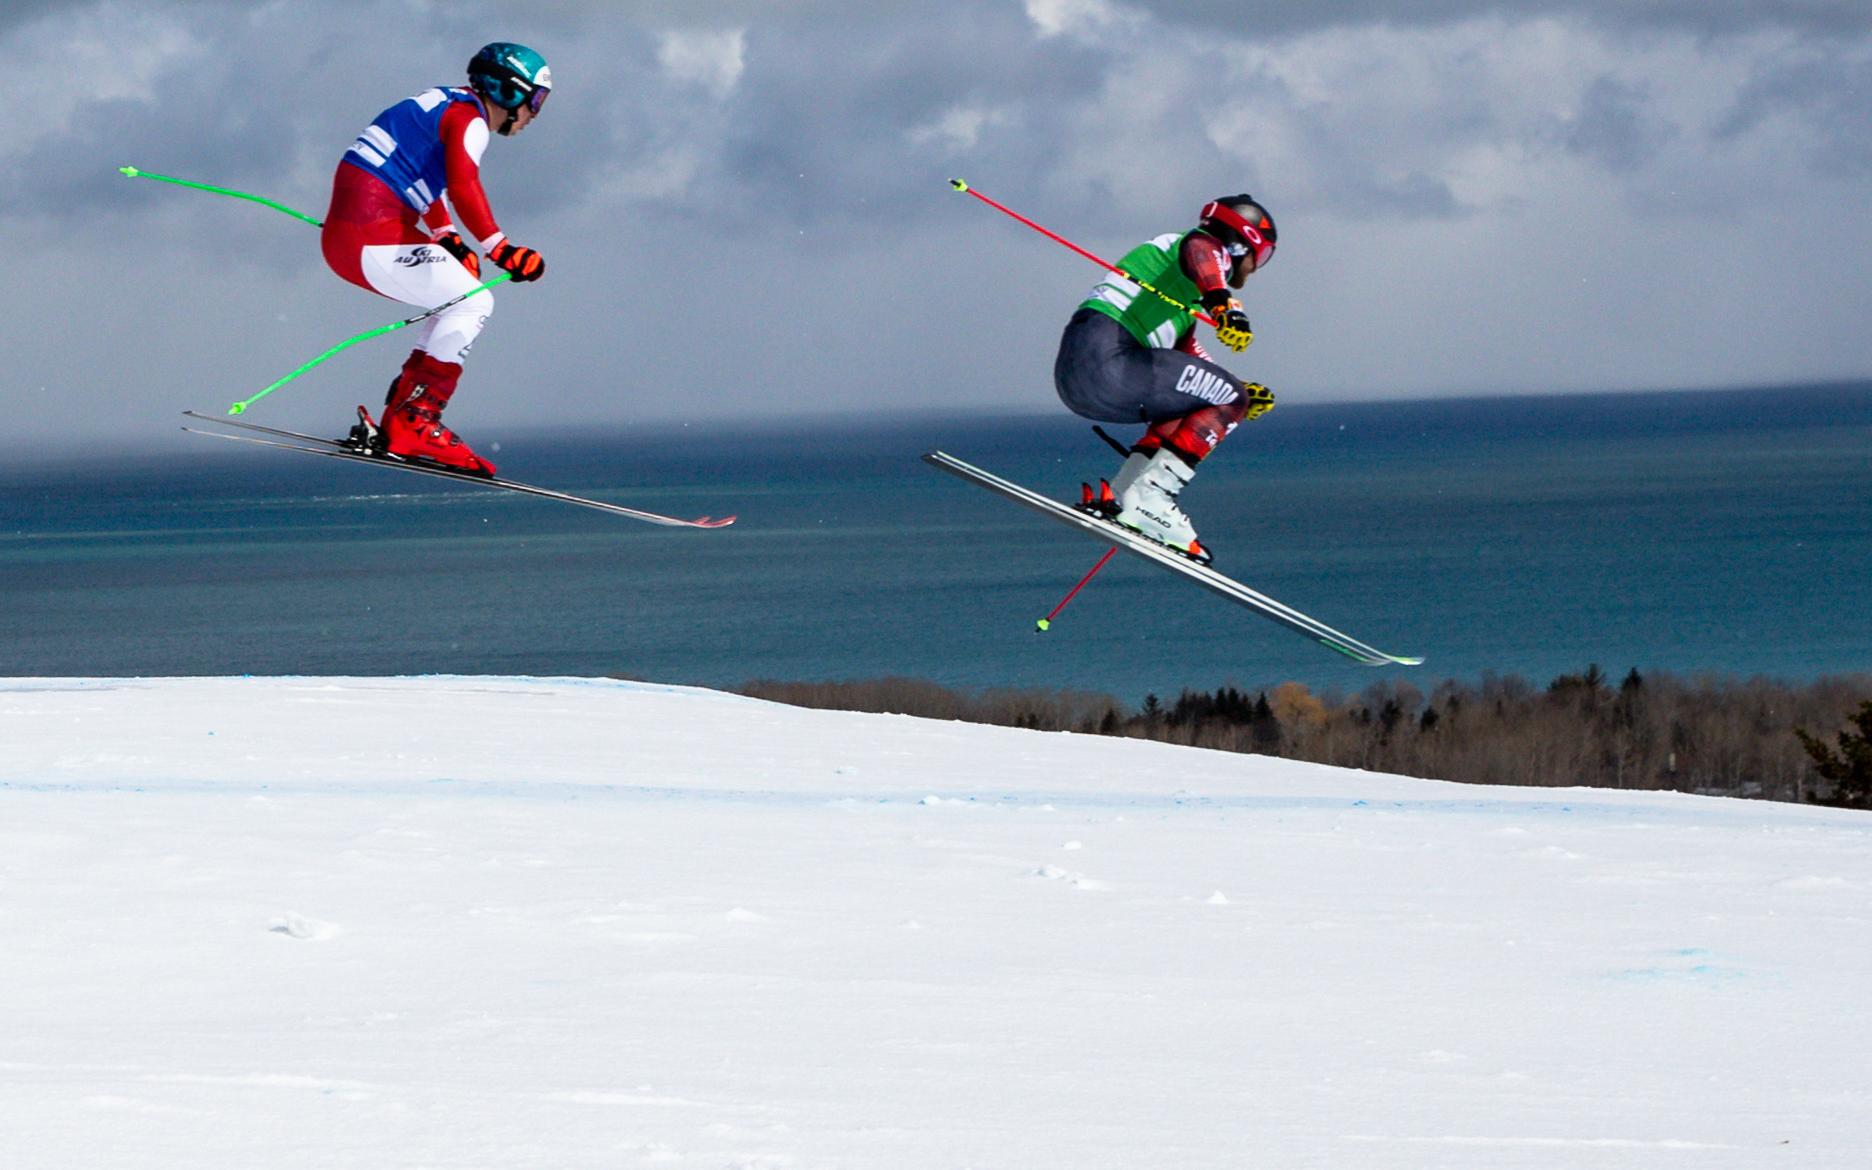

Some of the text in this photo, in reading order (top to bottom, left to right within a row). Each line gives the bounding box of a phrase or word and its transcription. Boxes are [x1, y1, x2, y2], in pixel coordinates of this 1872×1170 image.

[393, 255, 447, 267] AUSTRIA
[1175, 364, 1239, 405] CANADA
[1135, 506, 1171, 528] HEAD
